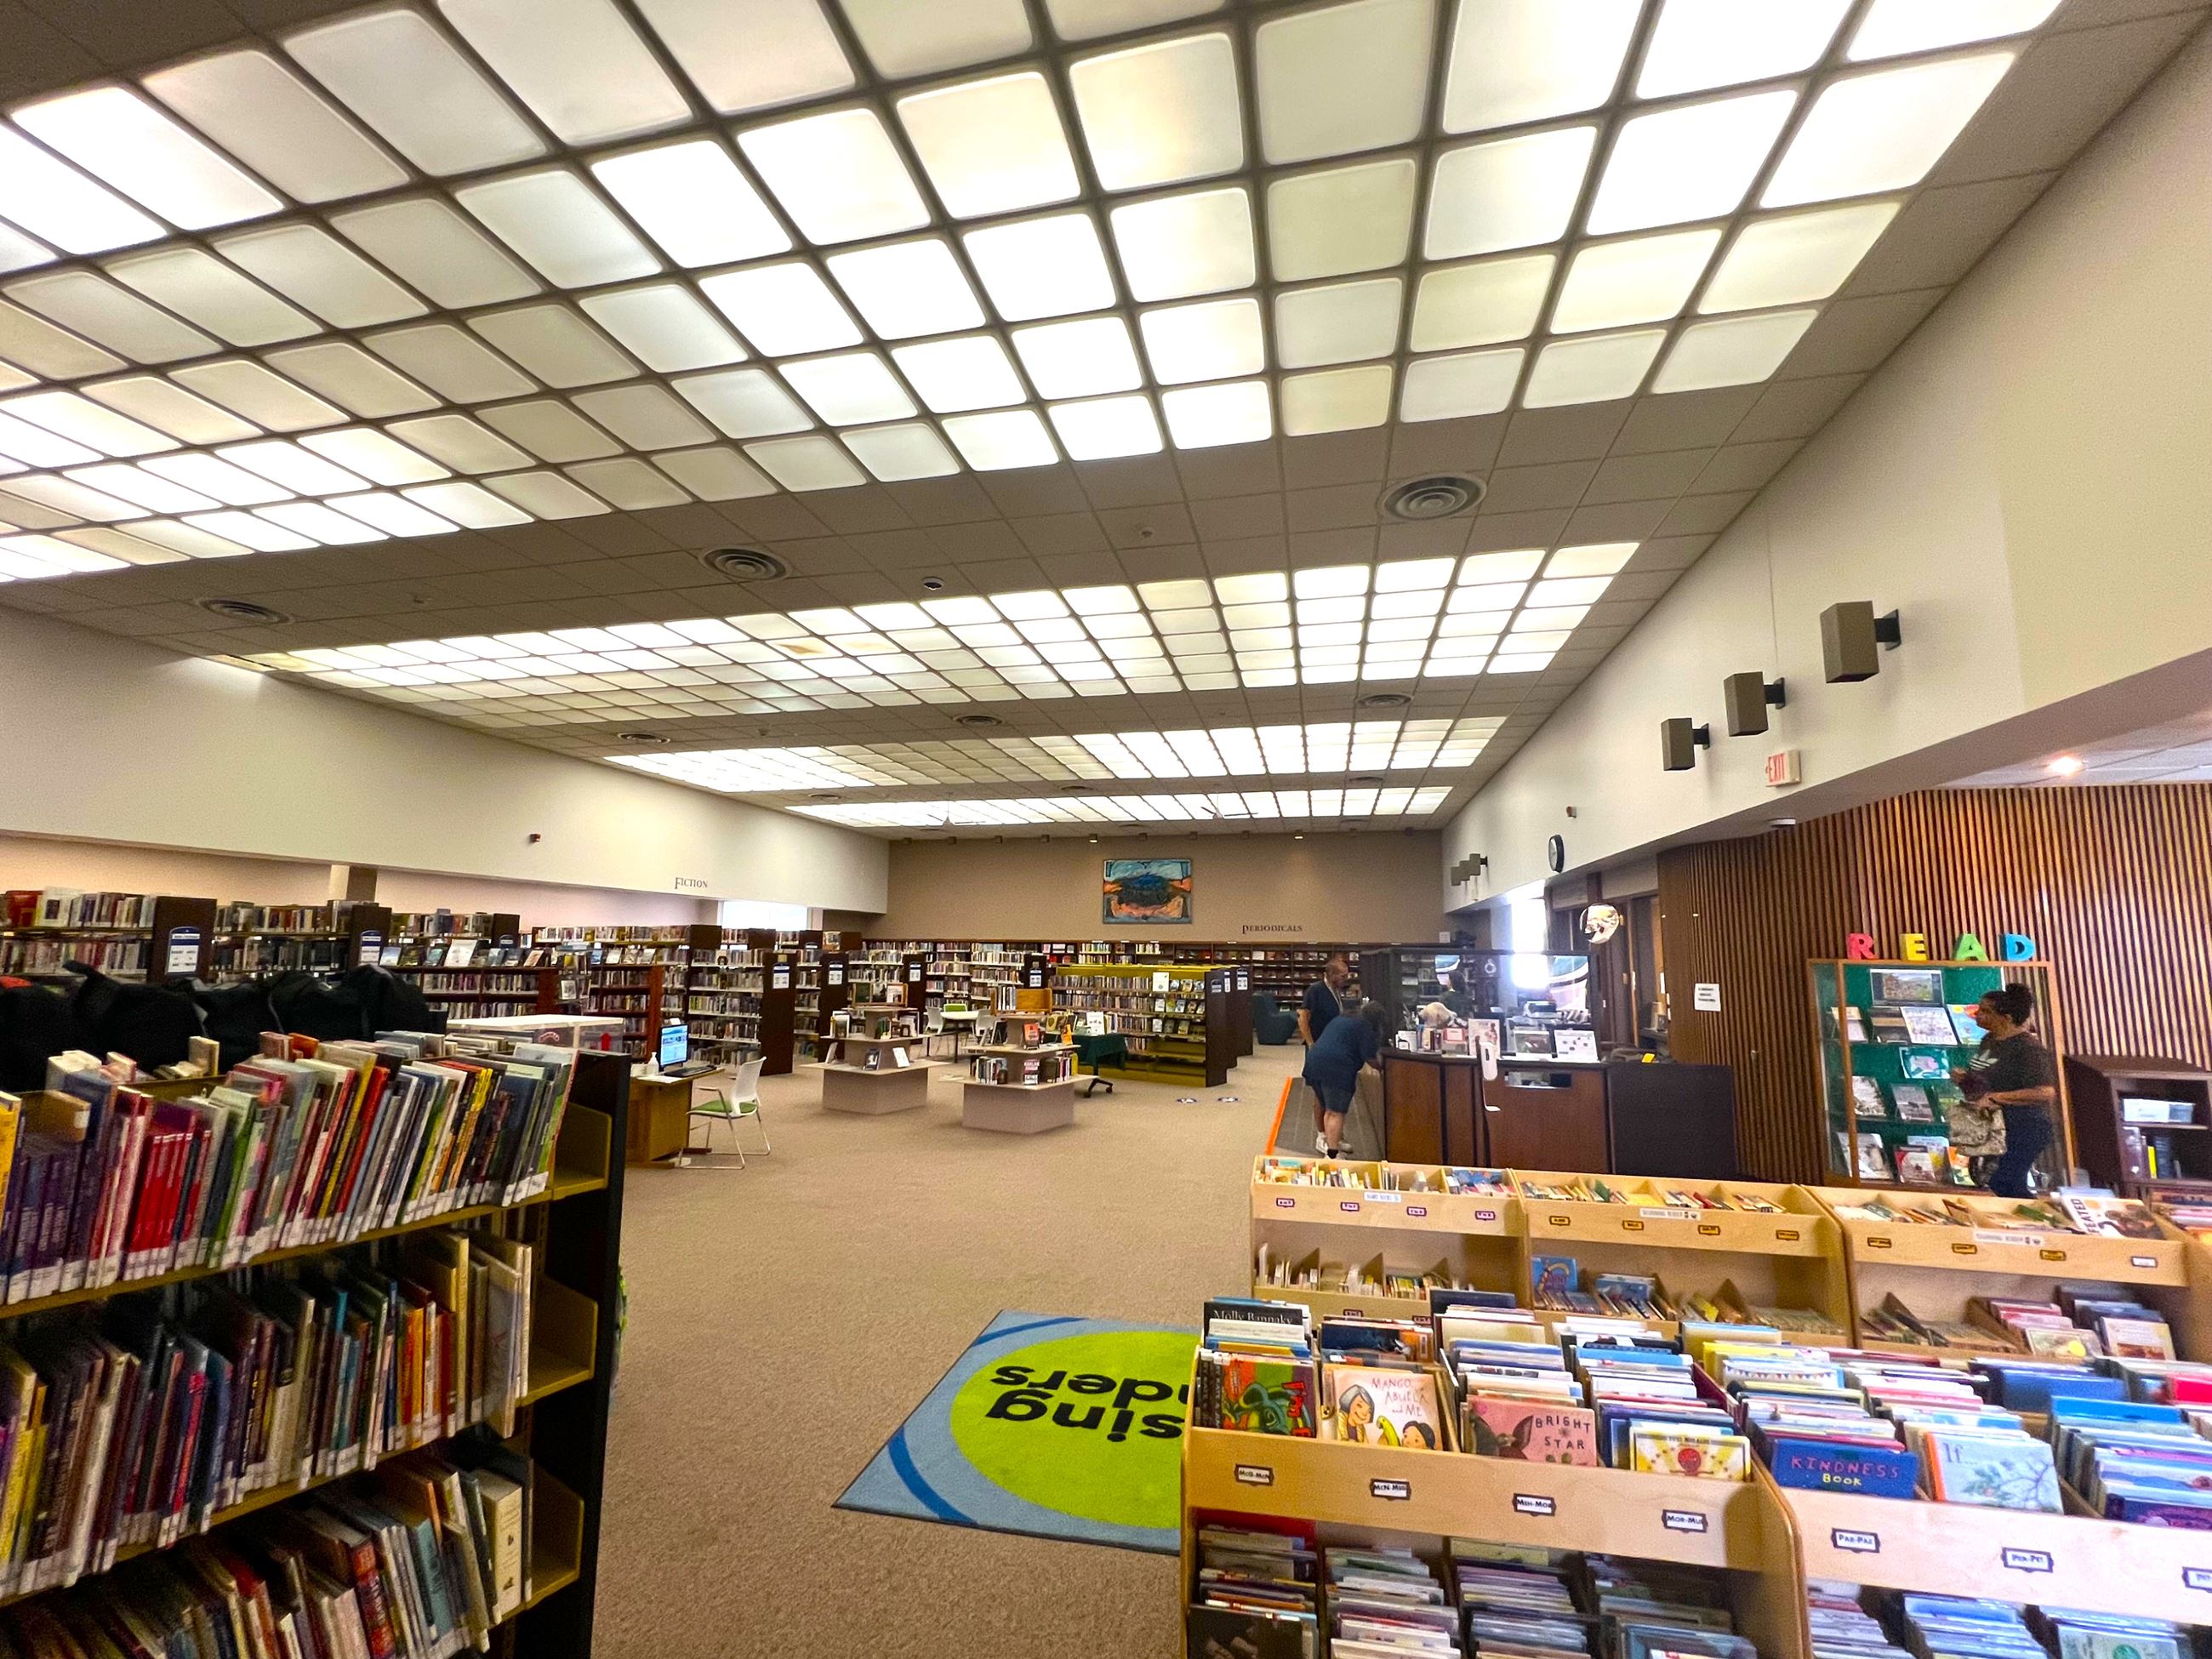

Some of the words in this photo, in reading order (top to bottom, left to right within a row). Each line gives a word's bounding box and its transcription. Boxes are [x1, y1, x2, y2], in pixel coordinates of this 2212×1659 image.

[1768, 753, 1785, 783] EXIT
[1242, 925, 1303, 935] PERIODICALS
[1847, 932, 2035, 962] READ
[1535, 1416, 1590, 1434] BRIGHT
[1544, 1436, 1585, 1450] STAR
[1791, 1456, 1900, 1479] KINDNESS
